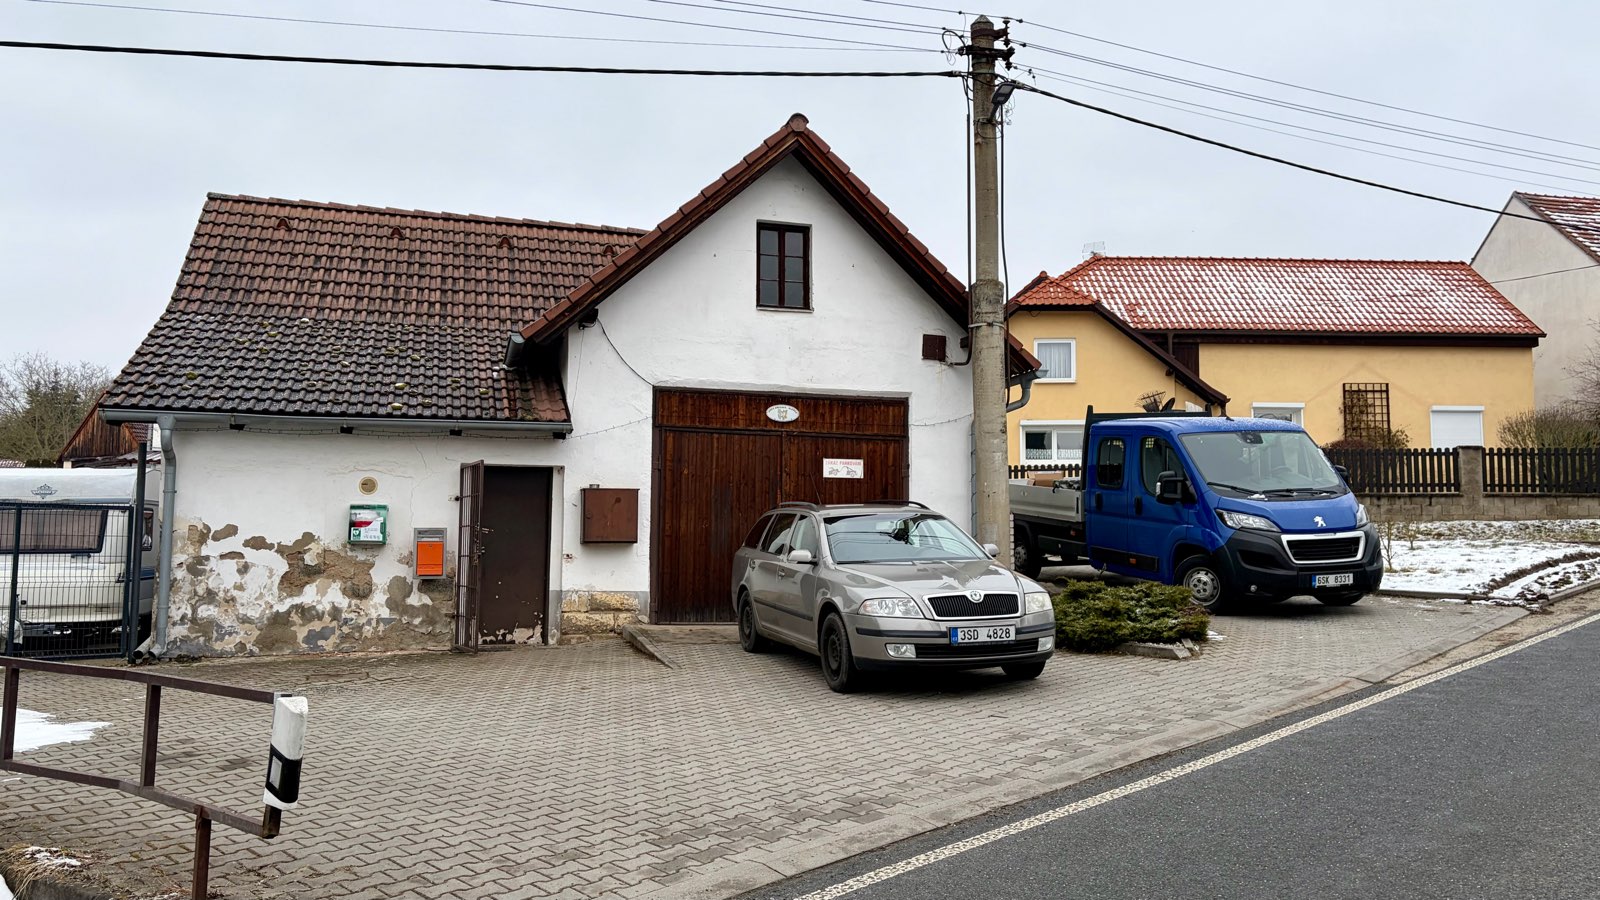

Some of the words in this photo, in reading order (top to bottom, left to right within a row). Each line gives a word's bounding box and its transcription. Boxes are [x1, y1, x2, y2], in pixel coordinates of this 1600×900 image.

[1317, 576, 1329, 585] 6SK
[1334, 575, 1350, 584] 8331
[960, 629, 979, 641] 3SD
[986, 628, 1011, 640] 4828
